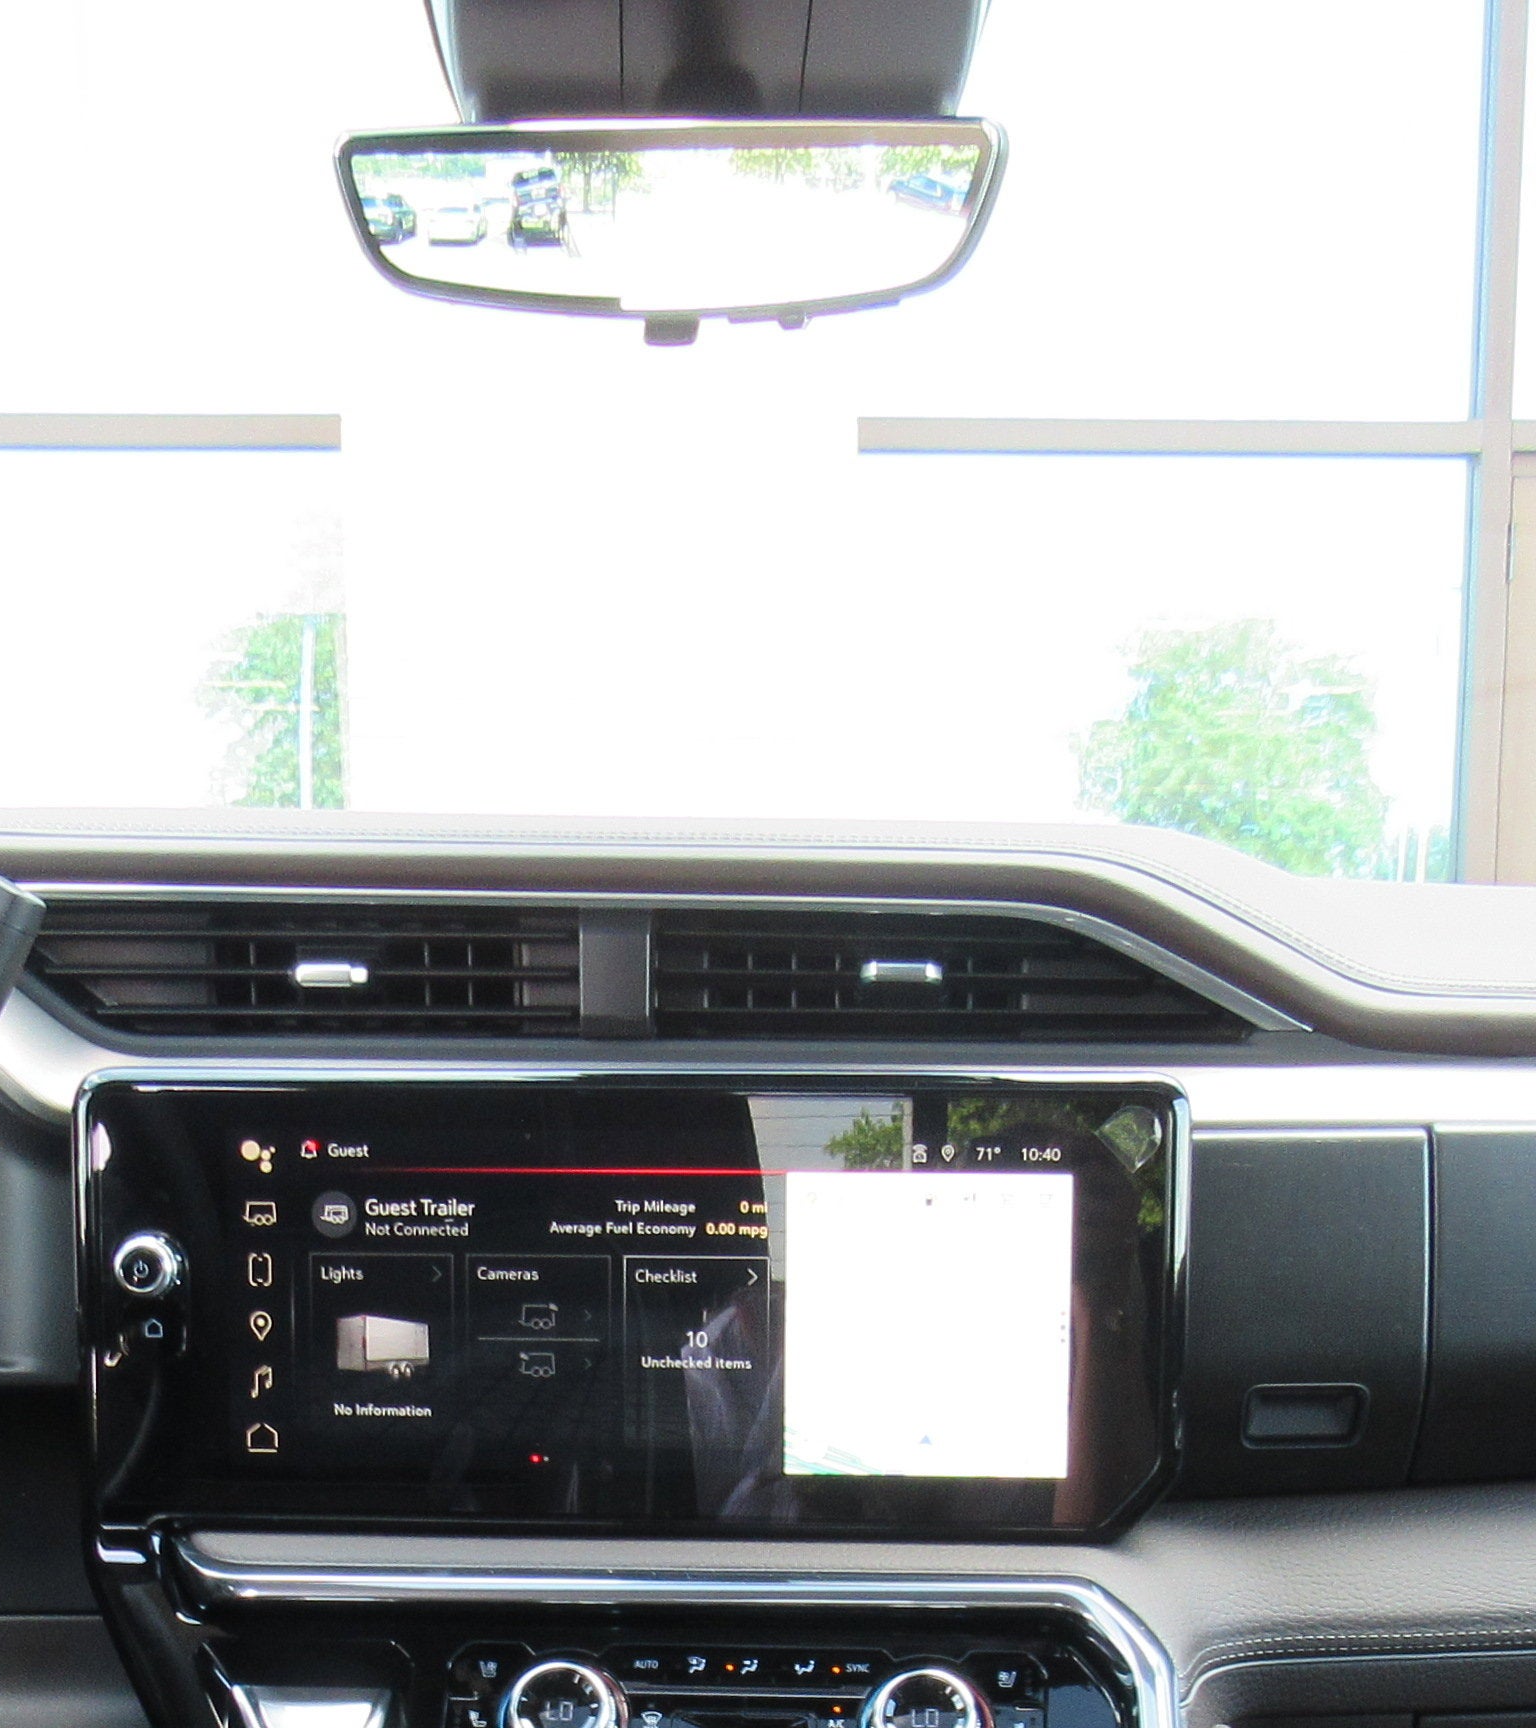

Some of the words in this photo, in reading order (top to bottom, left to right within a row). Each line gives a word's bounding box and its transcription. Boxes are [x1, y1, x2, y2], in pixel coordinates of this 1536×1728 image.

[327, 1143, 369, 1158] Guest
[1021, 1147, 1062, 1162] 10:40
[365, 1198, 417, 1216] Guest
[419, 1198, 475, 1217] Trailer
[615, 1200, 640, 1214] Trip
[643, 1200, 696, 1216] Mileage
[739, 1201, 749, 1214] 0
[752, 1201, 768, 1214] mi
[365, 1222, 390, 1237] Not
[393, 1222, 469, 1237] Connected
[549, 1222, 602, 1238] Average
[606, 1222, 633, 1235] Fuel
[637, 1222, 696, 1238] Economy
[705, 1223, 736, 1236] 0.00
[738, 1225, 768, 1239] mpg
[321, 1265, 364, 1284] Lights
[476, 1266, 540, 1281] Cameras
[635, 1269, 698, 1283] Checklist
[686, 1331, 708, 1348] 10
[641, 1356, 712, 1370] Unchecked
[715, 1357, 752, 1370] items
[334, 1403, 353, 1416] No
[356, 1403, 432, 1417] Information
[633, 1660, 659, 1669] AUTO
[845, 1663, 870, 1673] SYNC
[545, 1701, 574, 1721] LO
[911, 1708, 939, 1728] LO
[827, 1719, 845, 1728] A/C
